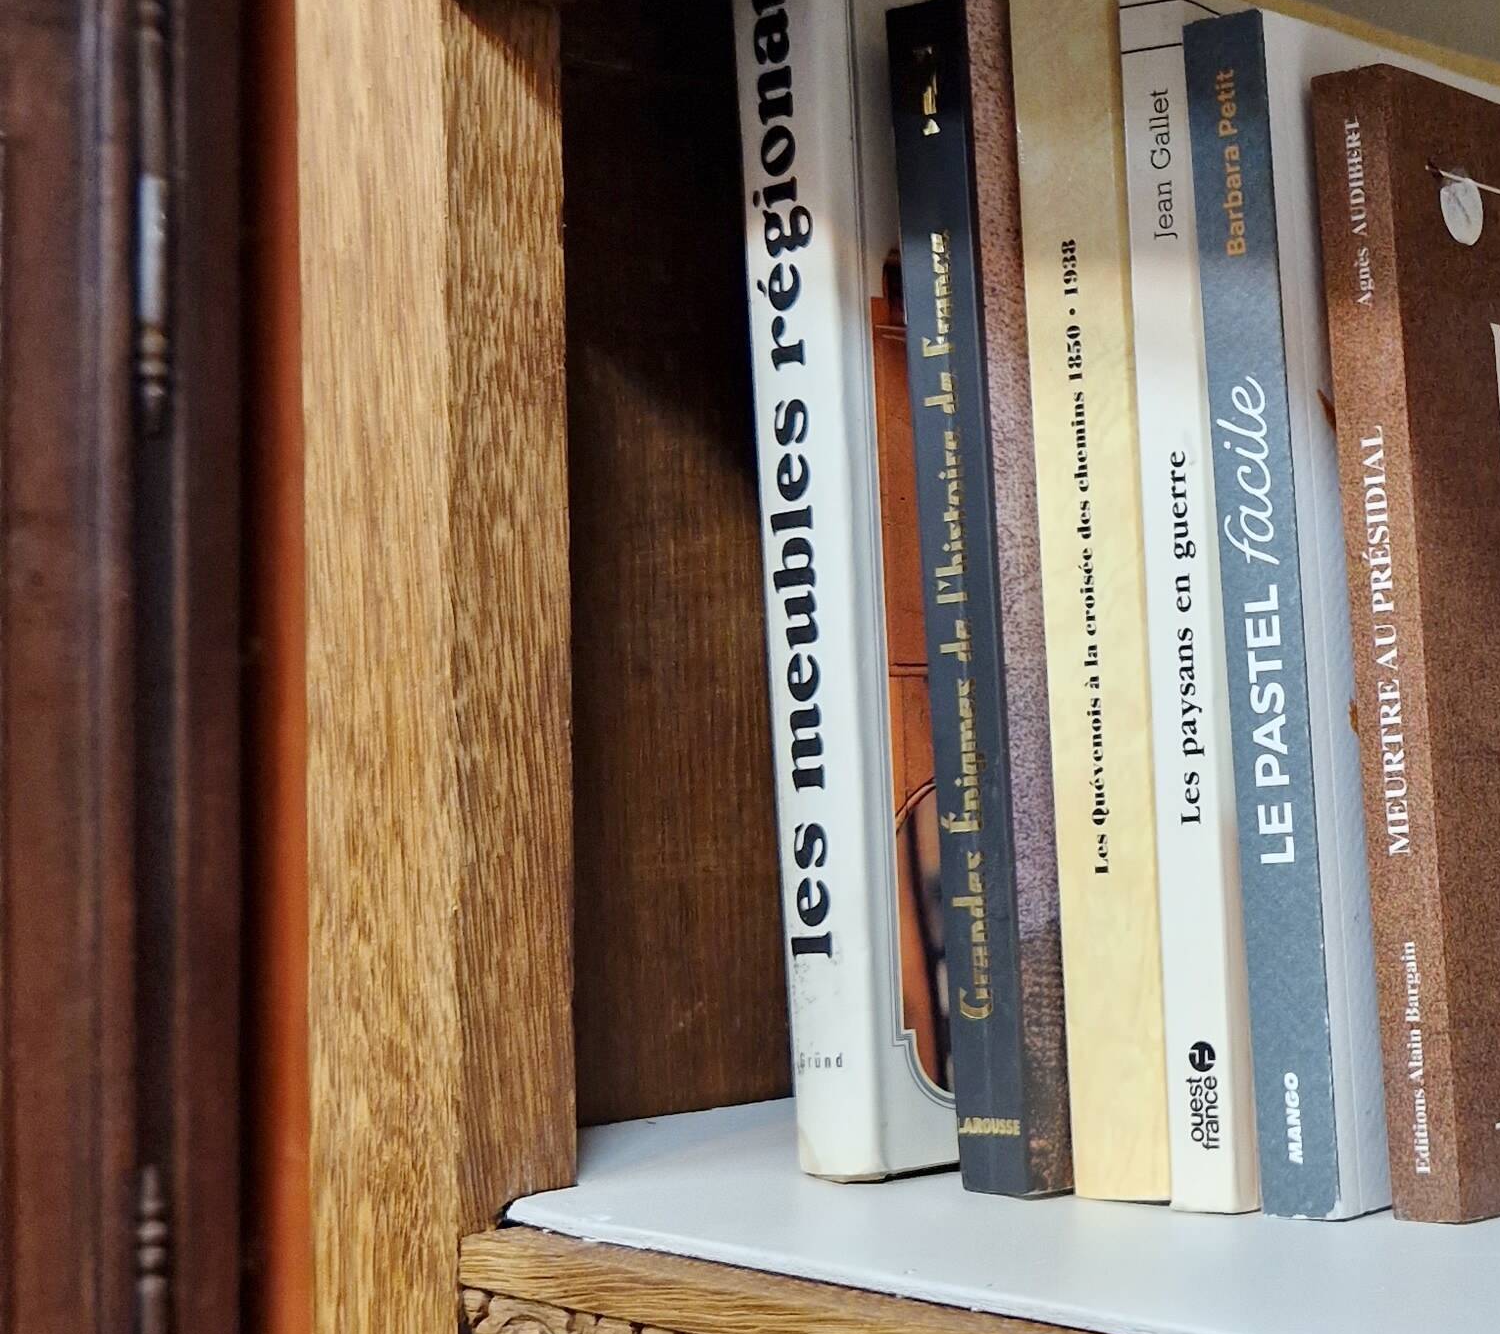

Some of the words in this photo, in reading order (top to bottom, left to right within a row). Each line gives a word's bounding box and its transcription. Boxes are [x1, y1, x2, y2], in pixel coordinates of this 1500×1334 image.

[1149, 88, 1172, 170] Gallet
[1215, 68, 1238, 138] Petit
[1153, 180, 1178, 240] Jean
[1223, 144, 1246, 257] Barbara
[1344, 115, 1367, 237] AUDIBERT
[921, 229, 956, 359] France
[1061, 239, 1078, 295] 1938
[1354, 247, 1375, 307] Agnès
[923, 371, 958, 415] de
[1066, 325, 1083, 381] 1850
[1071, 391, 1089, 493] chemins
[1216, 375, 1280, 566] facile
[935, 430, 968, 606] l'histoire
[1077, 499, 1093, 541] des
[1168, 450, 1197, 560] guerre
[1361, 425, 1394, 614] PRÉSIDIAL
[770, 398, 825, 794] meubles
[1078, 547, 1097, 637] croisée
[1175, 573, 1192, 613] en
[938, 618, 974, 662] de
[1084, 644, 1099, 667] la
[1374, 622, 1399, 680] AU
[1084, 676, 1101, 690] à
[1175, 626, 1205, 756] paysans
[1245, 584, 1290, 788] PASTEL
[1086, 697, 1110, 826] Quévenois
[1181, 771, 1202, 826] Les
[1379, 679, 1411, 857] MEURTRE
[1095, 832, 1109, 874] Les
[1257, 800, 1295, 865] LE
[791, 820, 832, 961] les
[952, 851, 993, 1021] Grandes
[1401, 941, 1421, 1022] Bargain
[1407, 1029, 1424, 1083] Alain
[958, 1116, 1021, 1137] LAROUSSE
[1185, 1076, 1205, 1142] ouest
[1202, 1075, 1220, 1150] france
[1284, 1072, 1304, 1164] MANGO
[1413, 1089, 1431, 1174] Editions
